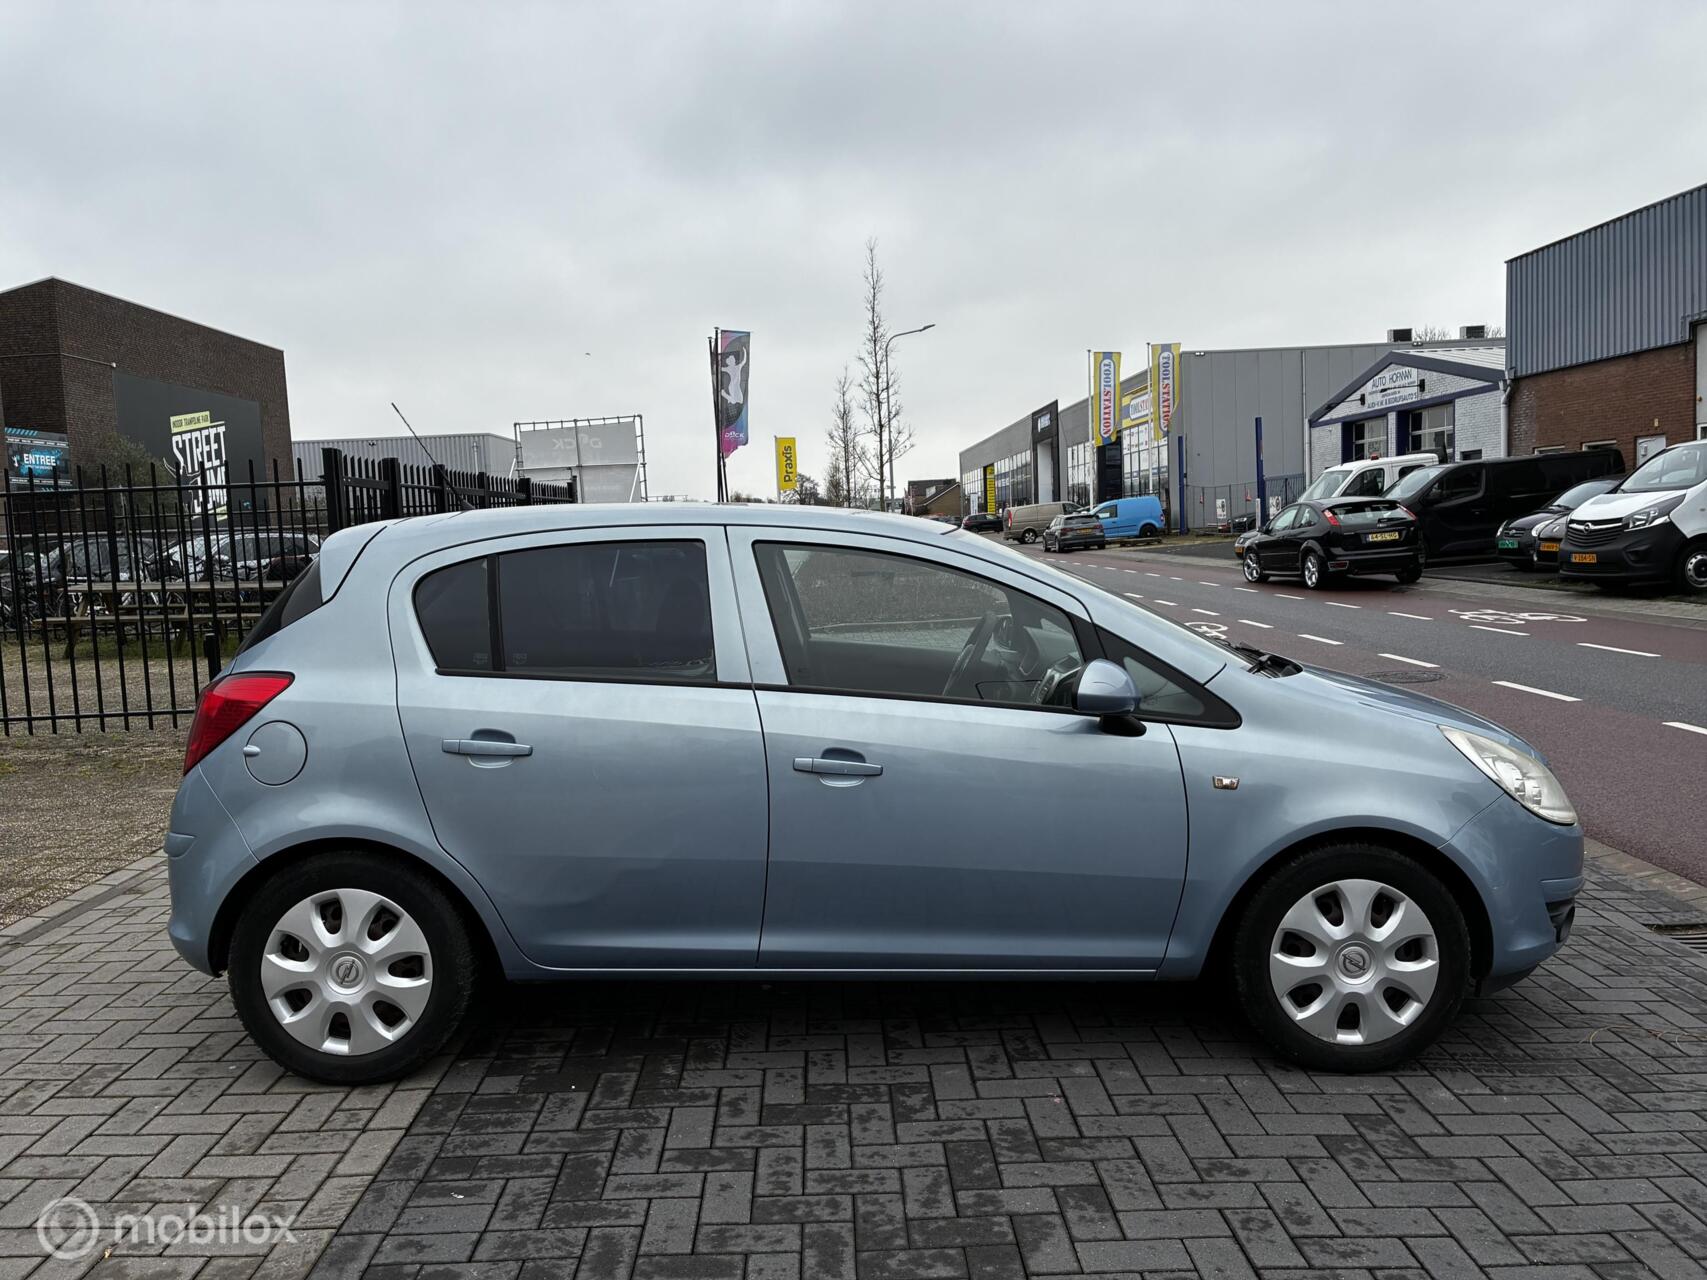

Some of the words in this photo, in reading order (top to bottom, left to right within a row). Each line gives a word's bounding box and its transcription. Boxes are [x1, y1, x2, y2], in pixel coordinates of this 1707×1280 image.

[1103, 361, 1112, 435] TOOLSTATION
[23, 453, 56, 466] ENTREE
[172, 426, 226, 475] STREET
[783, 445, 794, 483] Praxis
